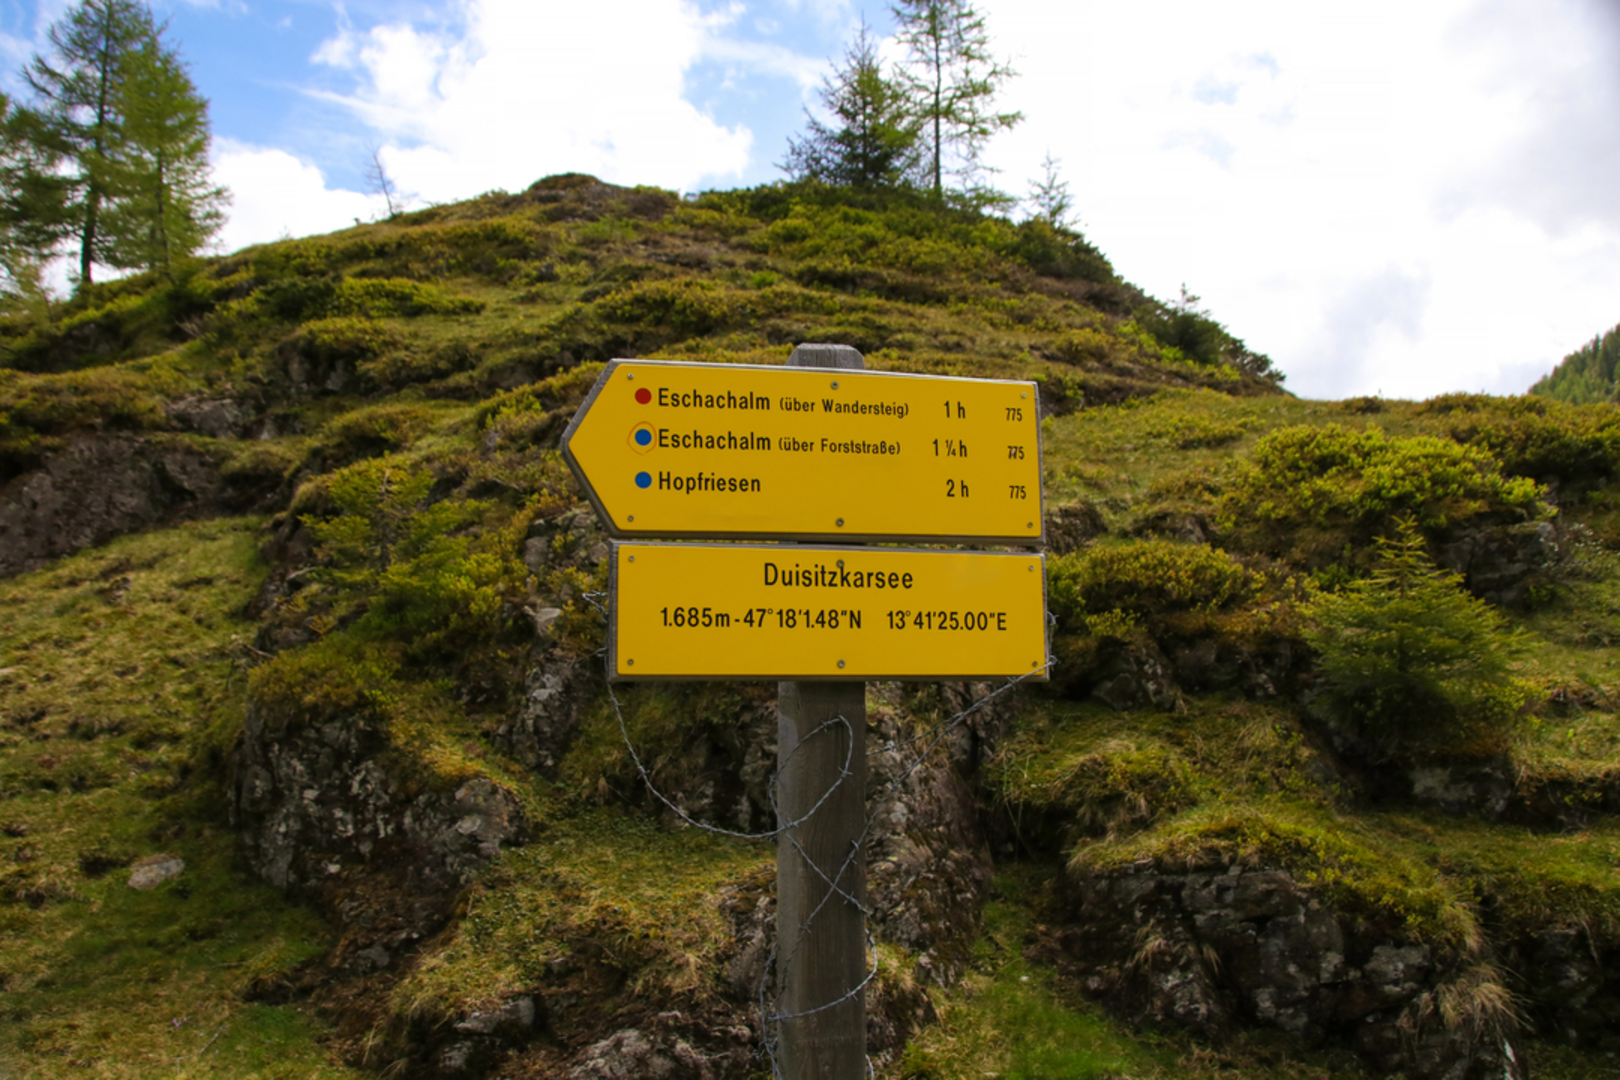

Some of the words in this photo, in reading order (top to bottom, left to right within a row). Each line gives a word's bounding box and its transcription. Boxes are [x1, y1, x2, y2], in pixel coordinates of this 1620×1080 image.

[658, 387, 771, 411] Eschachalm
[779, 397, 816, 412] (über
[821, 398, 909, 419] Wandersteig)
[1005, 407, 1023, 422] 775
[658, 428, 771, 451] Eschachalm
[778, 437, 815, 452] (über
[820, 437, 901, 455] Forststraße)
[1007, 445, 1025, 460] 775
[658, 471, 761, 495] Hopfriesen
[946, 478, 956, 498] 2
[1009, 485, 1027, 500] 775
[764, 562, 914, 590] Duisitzkarsee
